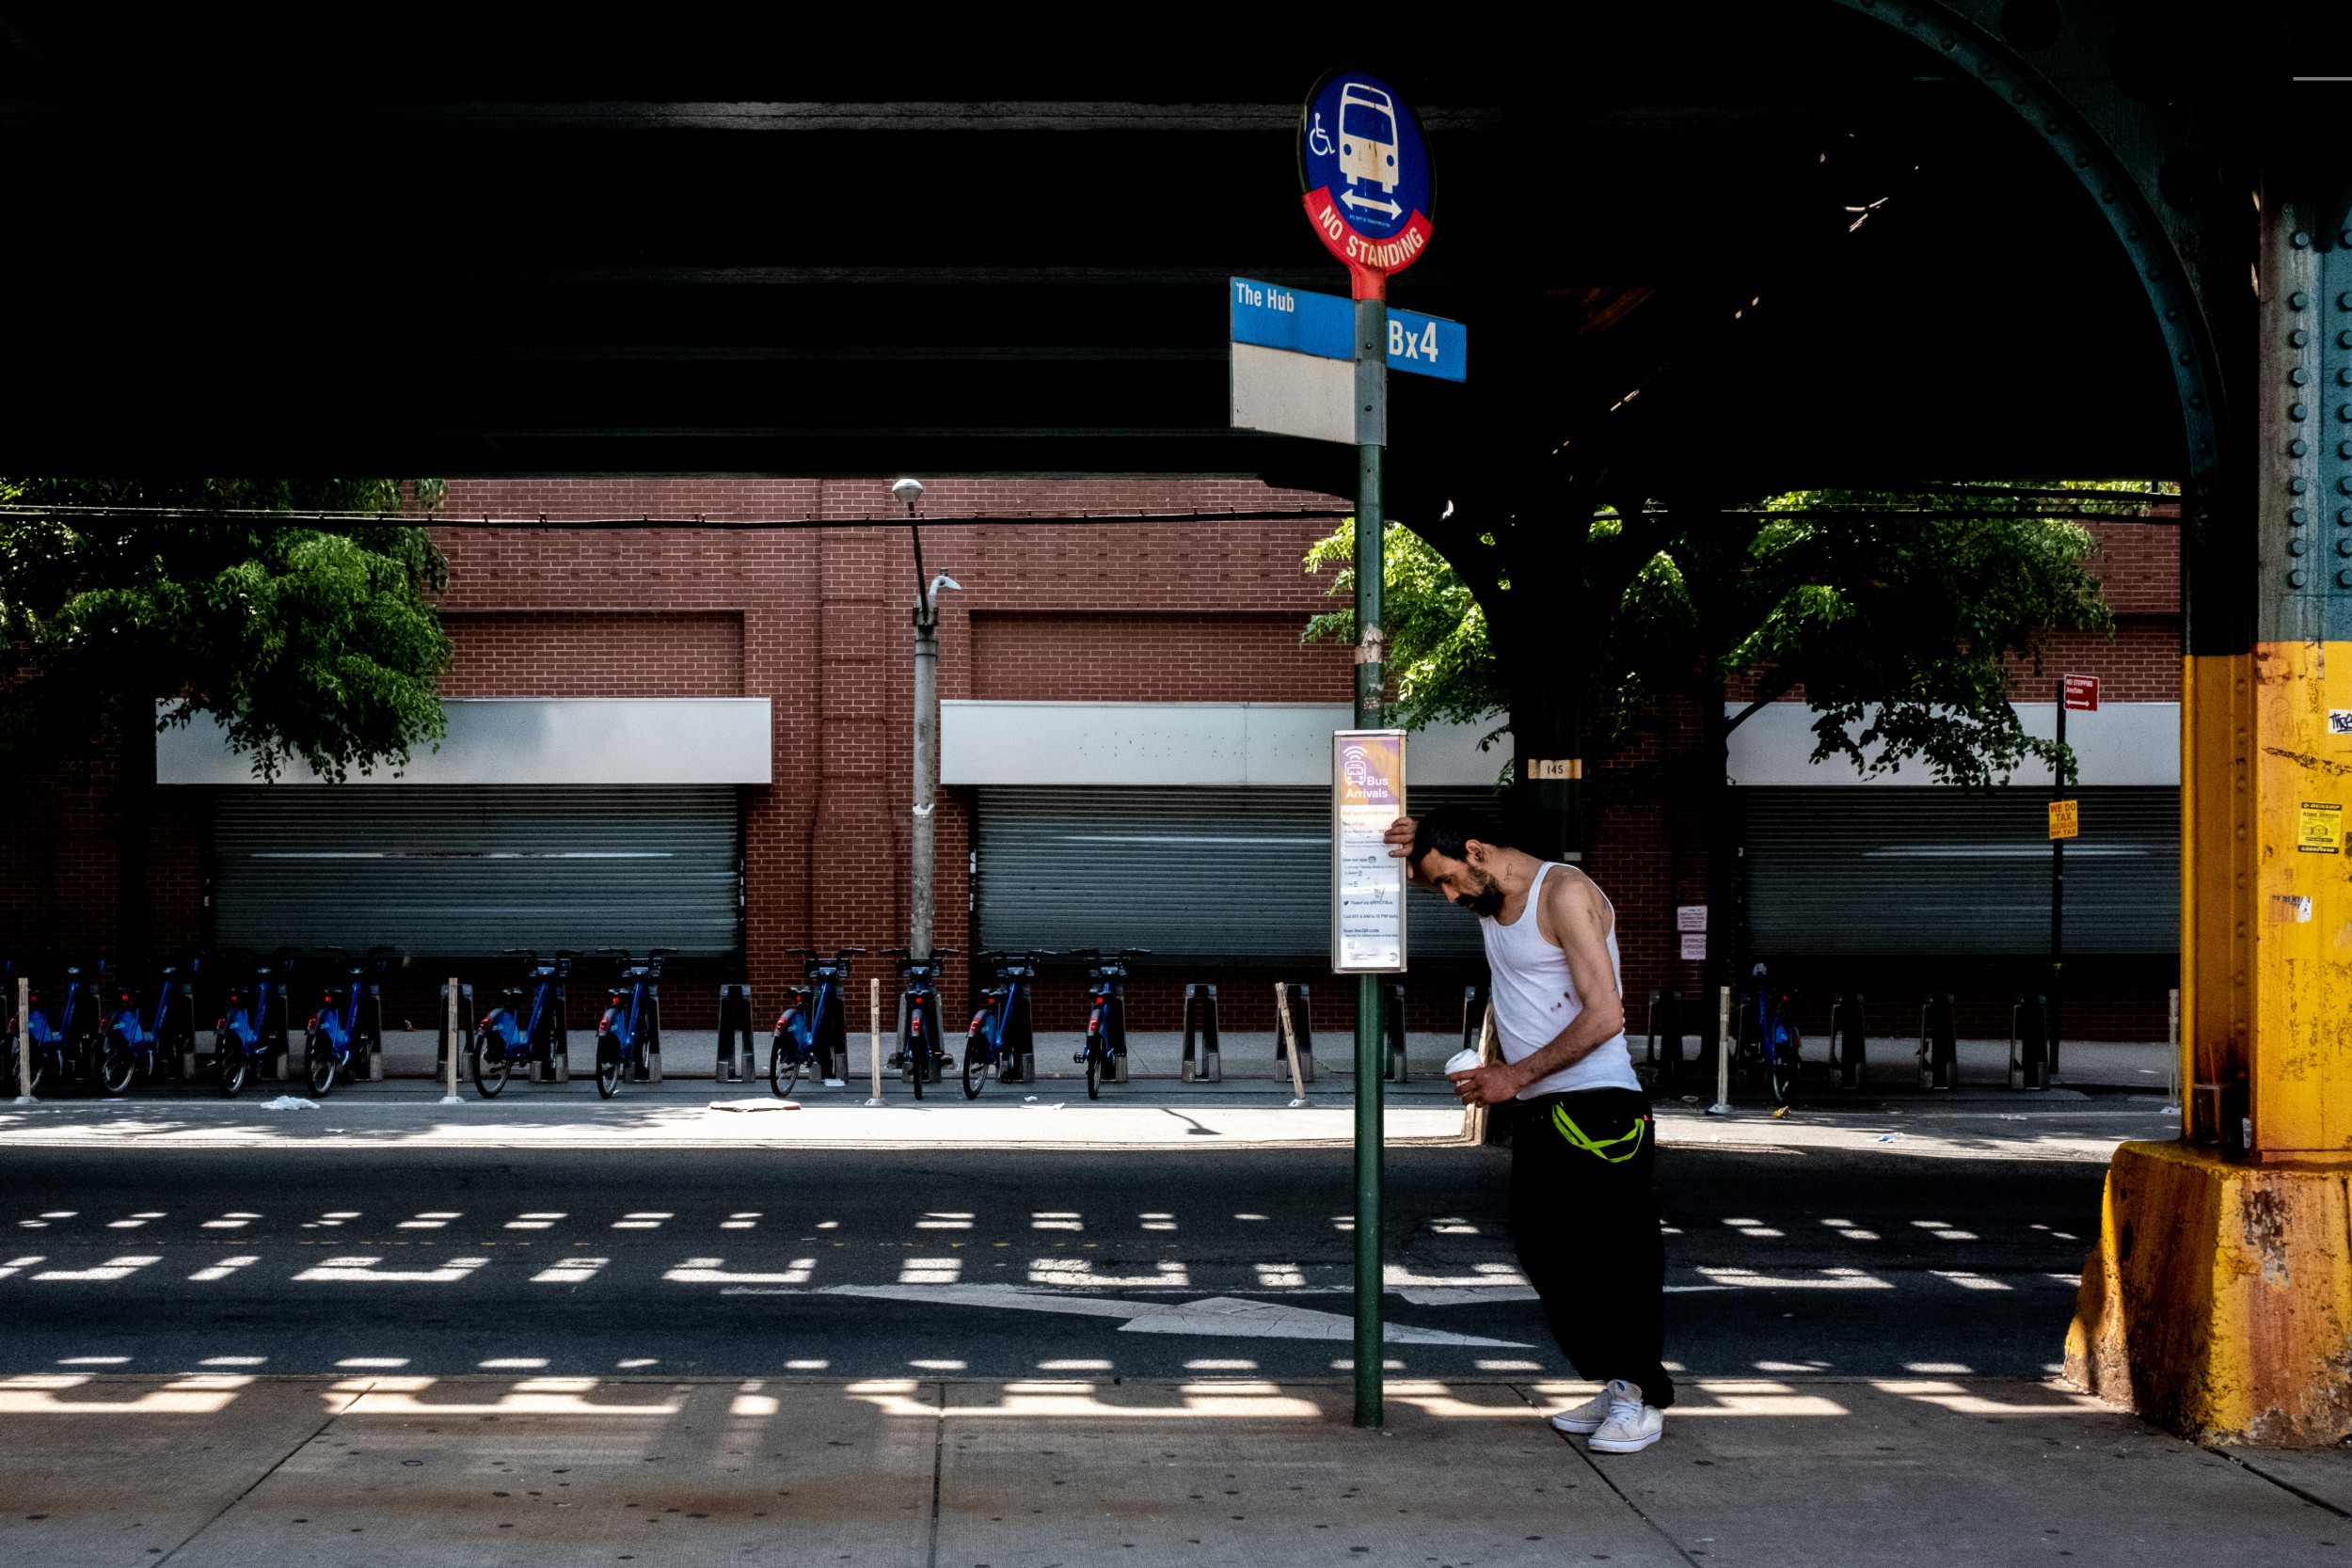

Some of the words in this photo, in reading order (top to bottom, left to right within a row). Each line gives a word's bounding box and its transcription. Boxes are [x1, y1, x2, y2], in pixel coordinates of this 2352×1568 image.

[1319, 205, 1343, 241] NO
[1346, 227, 1424, 267] STANDING
[1236, 282, 1262, 307] The
[1267, 288, 1295, 312] Hub
[1389, 320, 1438, 363] Bx4
[2073, 679, 2093, 688] STOPPING
[1367, 776, 1389, 785] Bus
[1345, 788, 1389, 799] Arrivals
[2050, 804, 2062, 813] WE
[2065, 802, 2076, 812] DO
[2055, 812, 2072, 822] TAX
